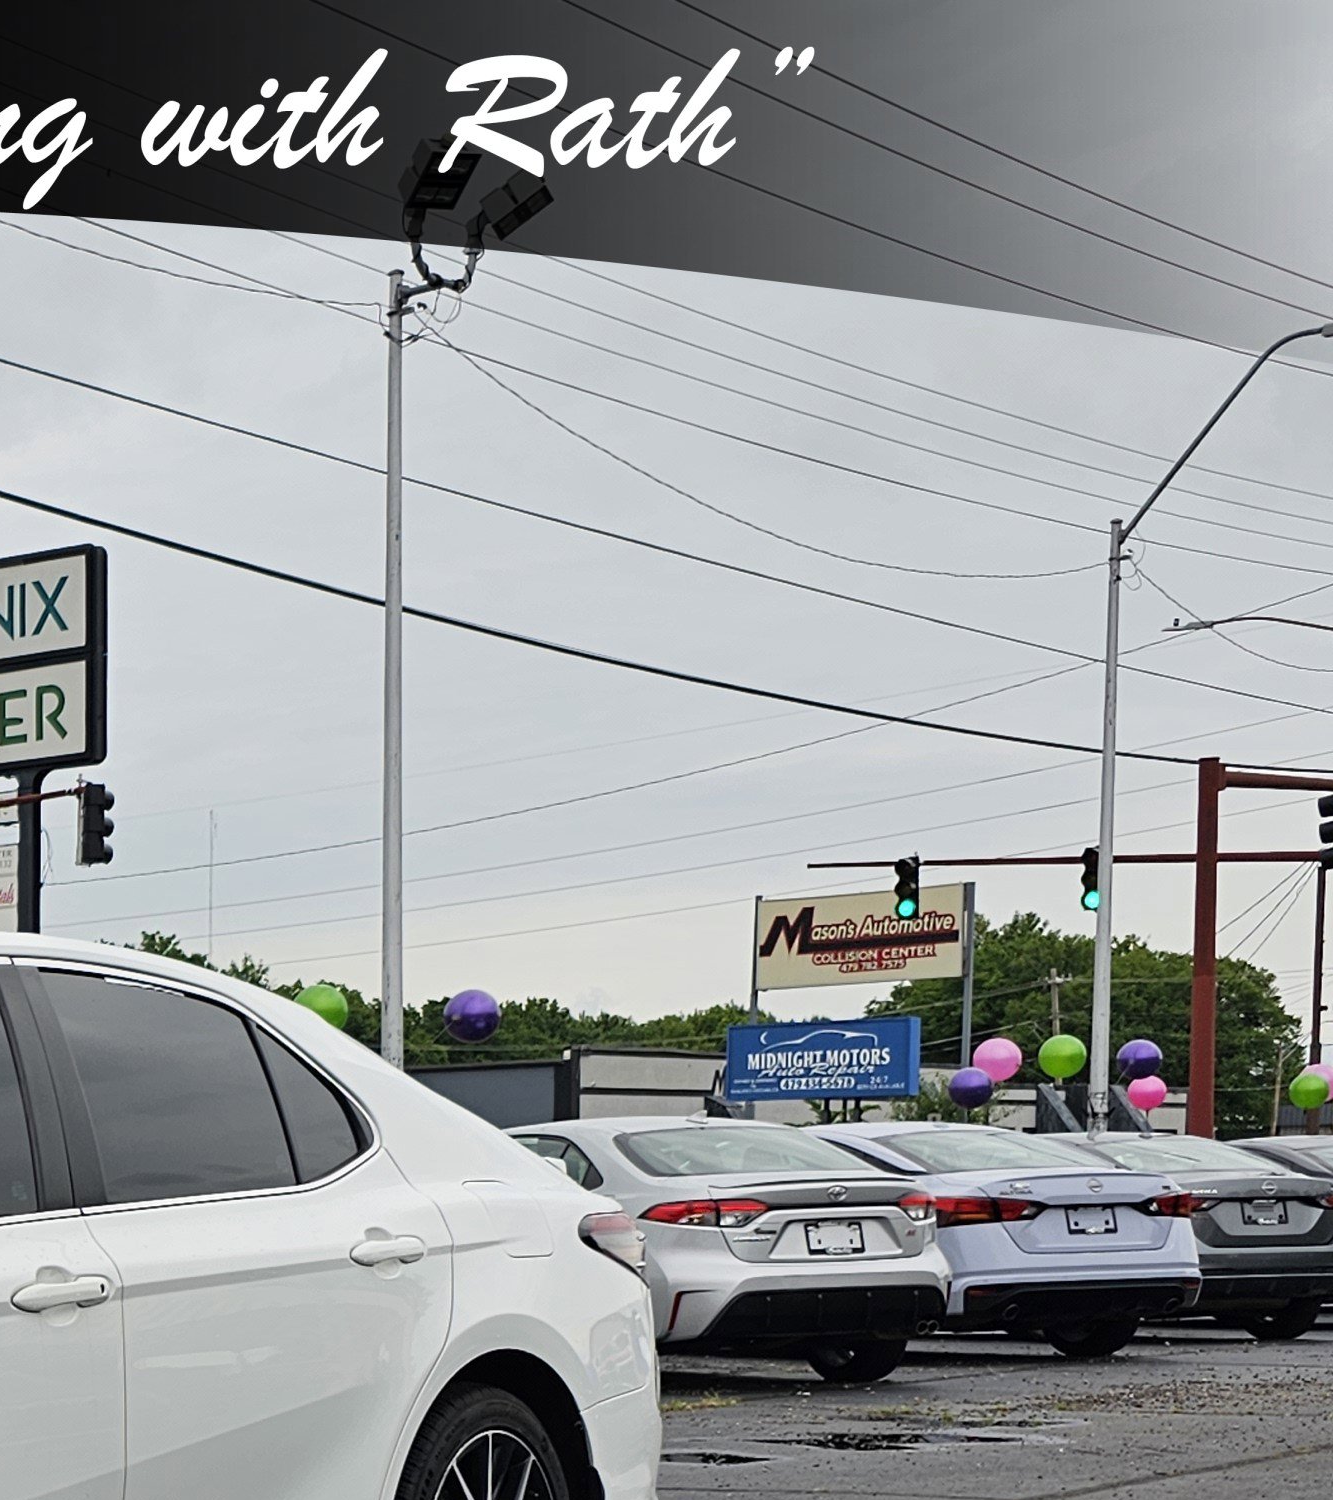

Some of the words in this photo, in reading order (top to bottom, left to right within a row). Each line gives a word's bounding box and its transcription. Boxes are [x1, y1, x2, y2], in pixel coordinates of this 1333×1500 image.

[859, 913, 955, 938] Automotive
[813, 951, 878, 964] COLLISION
[882, 946, 934, 959] CENTER
[747, 1051, 821, 1071] MIDNIGHT
[826, 1047, 891, 1065] MOTORS
[757, 1065, 804, 1078] Auto
[810, 1061, 876, 1080] Repair
